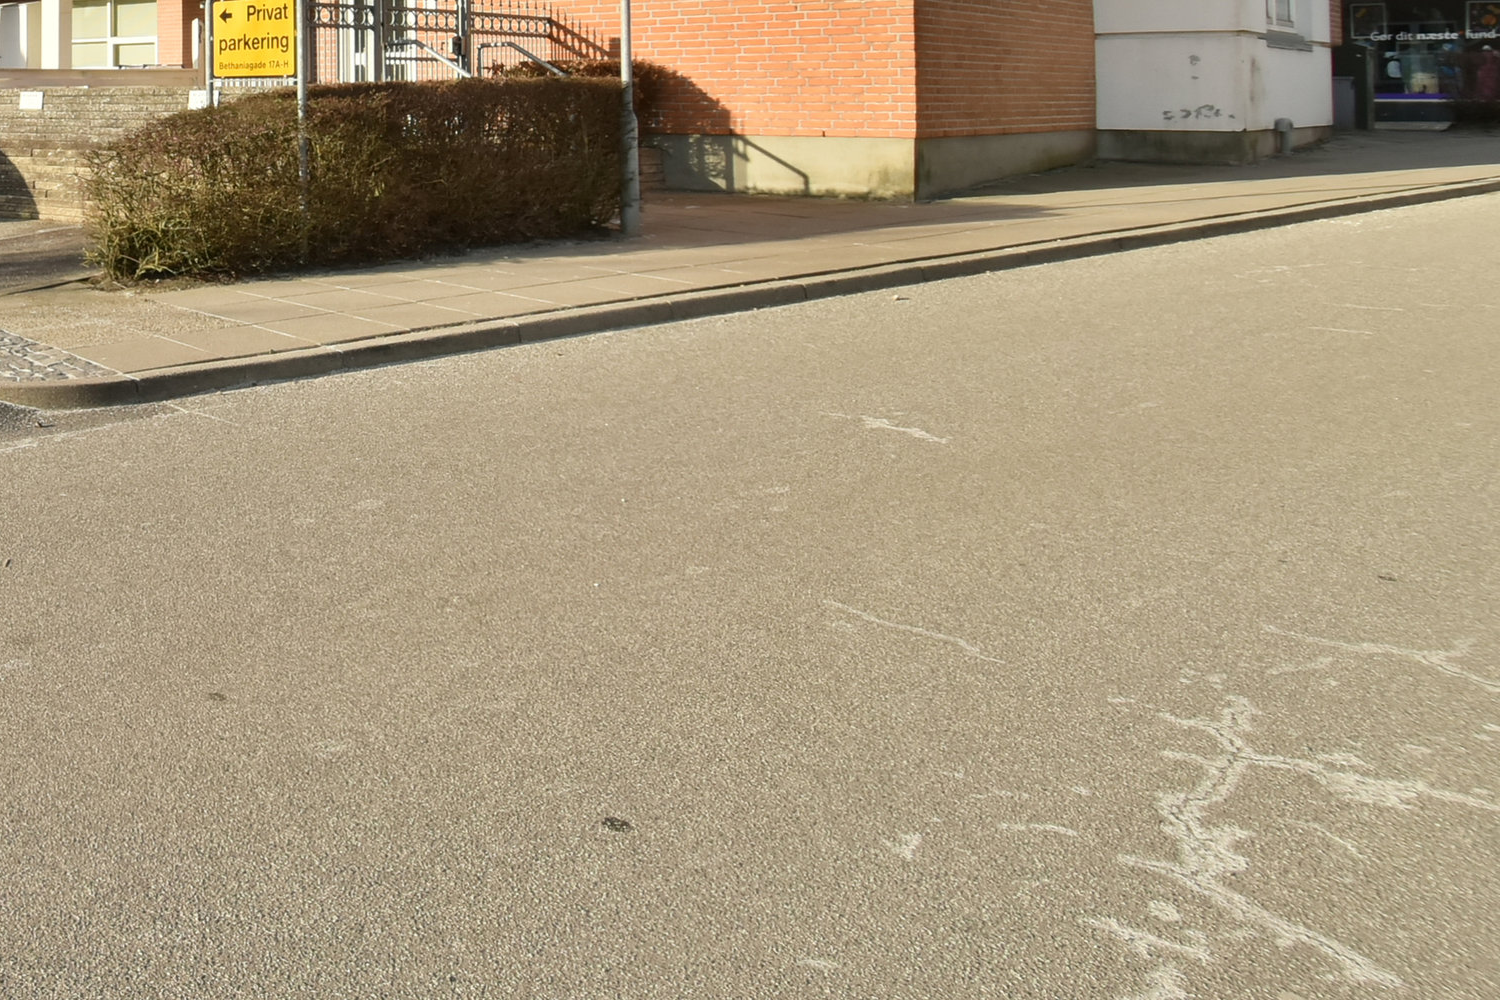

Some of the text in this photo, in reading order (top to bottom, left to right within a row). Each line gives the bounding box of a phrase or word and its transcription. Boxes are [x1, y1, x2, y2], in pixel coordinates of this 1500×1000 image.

[246, 3, 289, 22] Privat
[219, 32, 289, 55] parkering
[1370, 31, 1393, 42] Gør
[1395, 30, 1414, 41] dit
[1415, 29, 1459, 41] næste
[219, 60, 289, 72] Bethaniagade 17A-H
